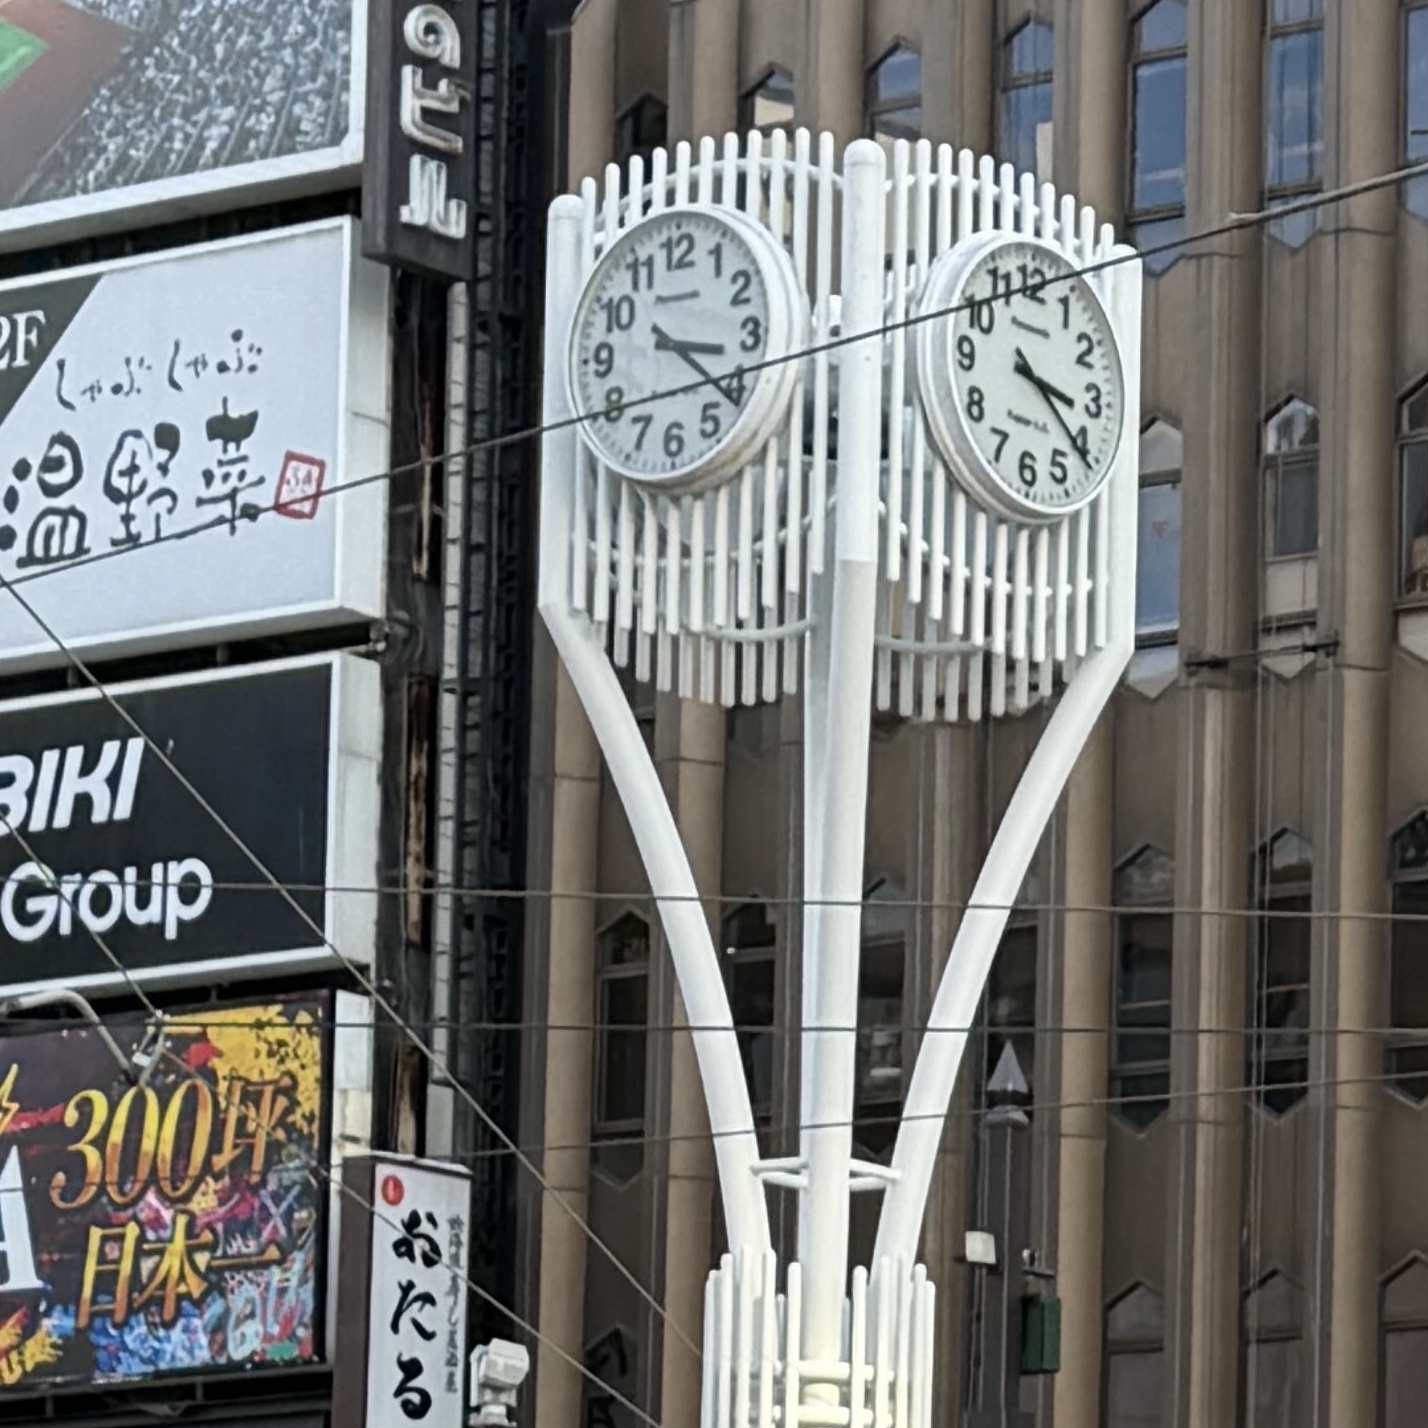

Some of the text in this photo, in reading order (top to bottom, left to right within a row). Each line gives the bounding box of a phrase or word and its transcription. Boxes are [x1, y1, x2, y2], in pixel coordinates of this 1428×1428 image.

[659, 233, 696, 271] 12
[708, 242, 723, 278] 1
[626, 254, 654, 292] 11
[730, 269, 751, 307] 2
[986, 266, 1011, 307] 11
[1017, 263, 1047, 305] 12
[600, 294, 635, 333] 10
[965, 294, 995, 335] 10
[1058, 295, 1069, 330] 1
[740, 316, 761, 351] 3
[1075, 332, 1094, 369] 2
[56, 328, 264, 412] しゃぶしゃぶ
[593, 342, 614, 379] 9
[957, 335, 975, 371] 9
[604, 386, 624, 423] 8
[966, 385, 984, 423] 8
[1084, 382, 1101, 418] 3
[632, 414, 653, 452] 7
[663, 421, 684, 457] 6
[700, 402, 721, 439] 5
[990, 426, 1010, 463] 7
[1018, 450, 1037, 487] 6
[1050, 449, 1067, 485] 5
[3, 857, 213, 942] Group
[50, 1075, 293, 1210] 300坪
[76, 1211, 282, 1329] 日本一
